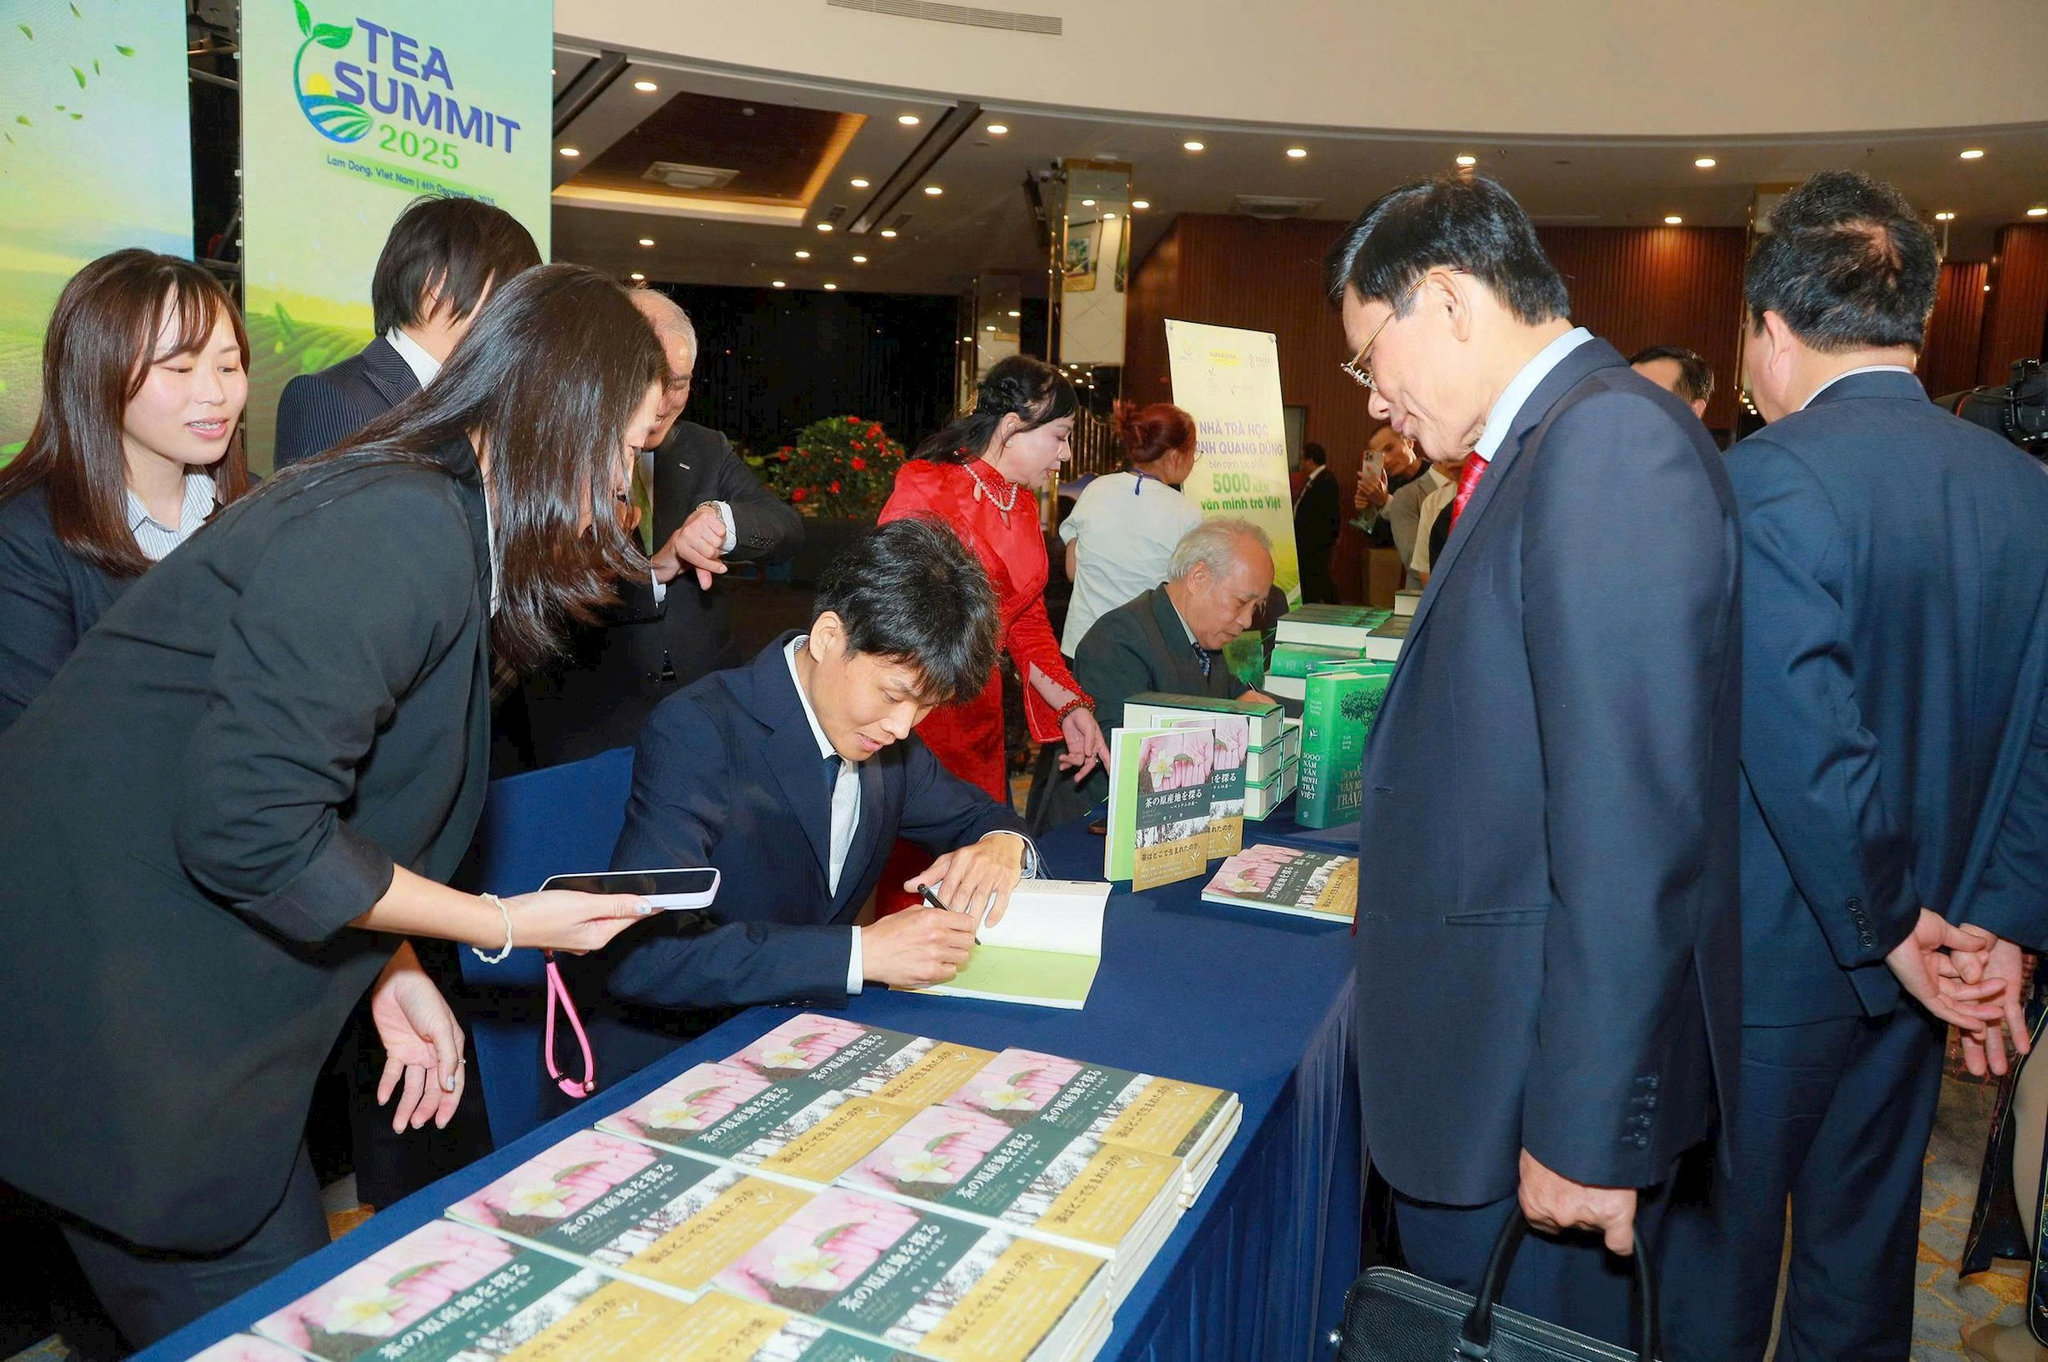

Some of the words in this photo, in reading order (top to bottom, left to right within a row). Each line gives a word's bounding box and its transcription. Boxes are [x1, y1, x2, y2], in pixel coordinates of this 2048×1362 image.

[355, 16, 454, 90] TEA
[334, 60, 521, 153] SUMMIT
[379, 123, 460, 170] 2025
[327, 154, 345, 168] Lam
[348, 160, 373, 178] Dong,
[376, 168, 394, 181] Viet
[396, 173, 415, 186] Nam
[1199, 418, 1224, 435] NHÀ
[1225, 419, 1246, 436] TRÀ
[1219, 440, 1257, 455] QUANG
[1212, 472, 1250, 494] 5000
[1222, 496, 1248, 511] minh
[1145, 789, 1203, 808] 茶の原産地を探る
